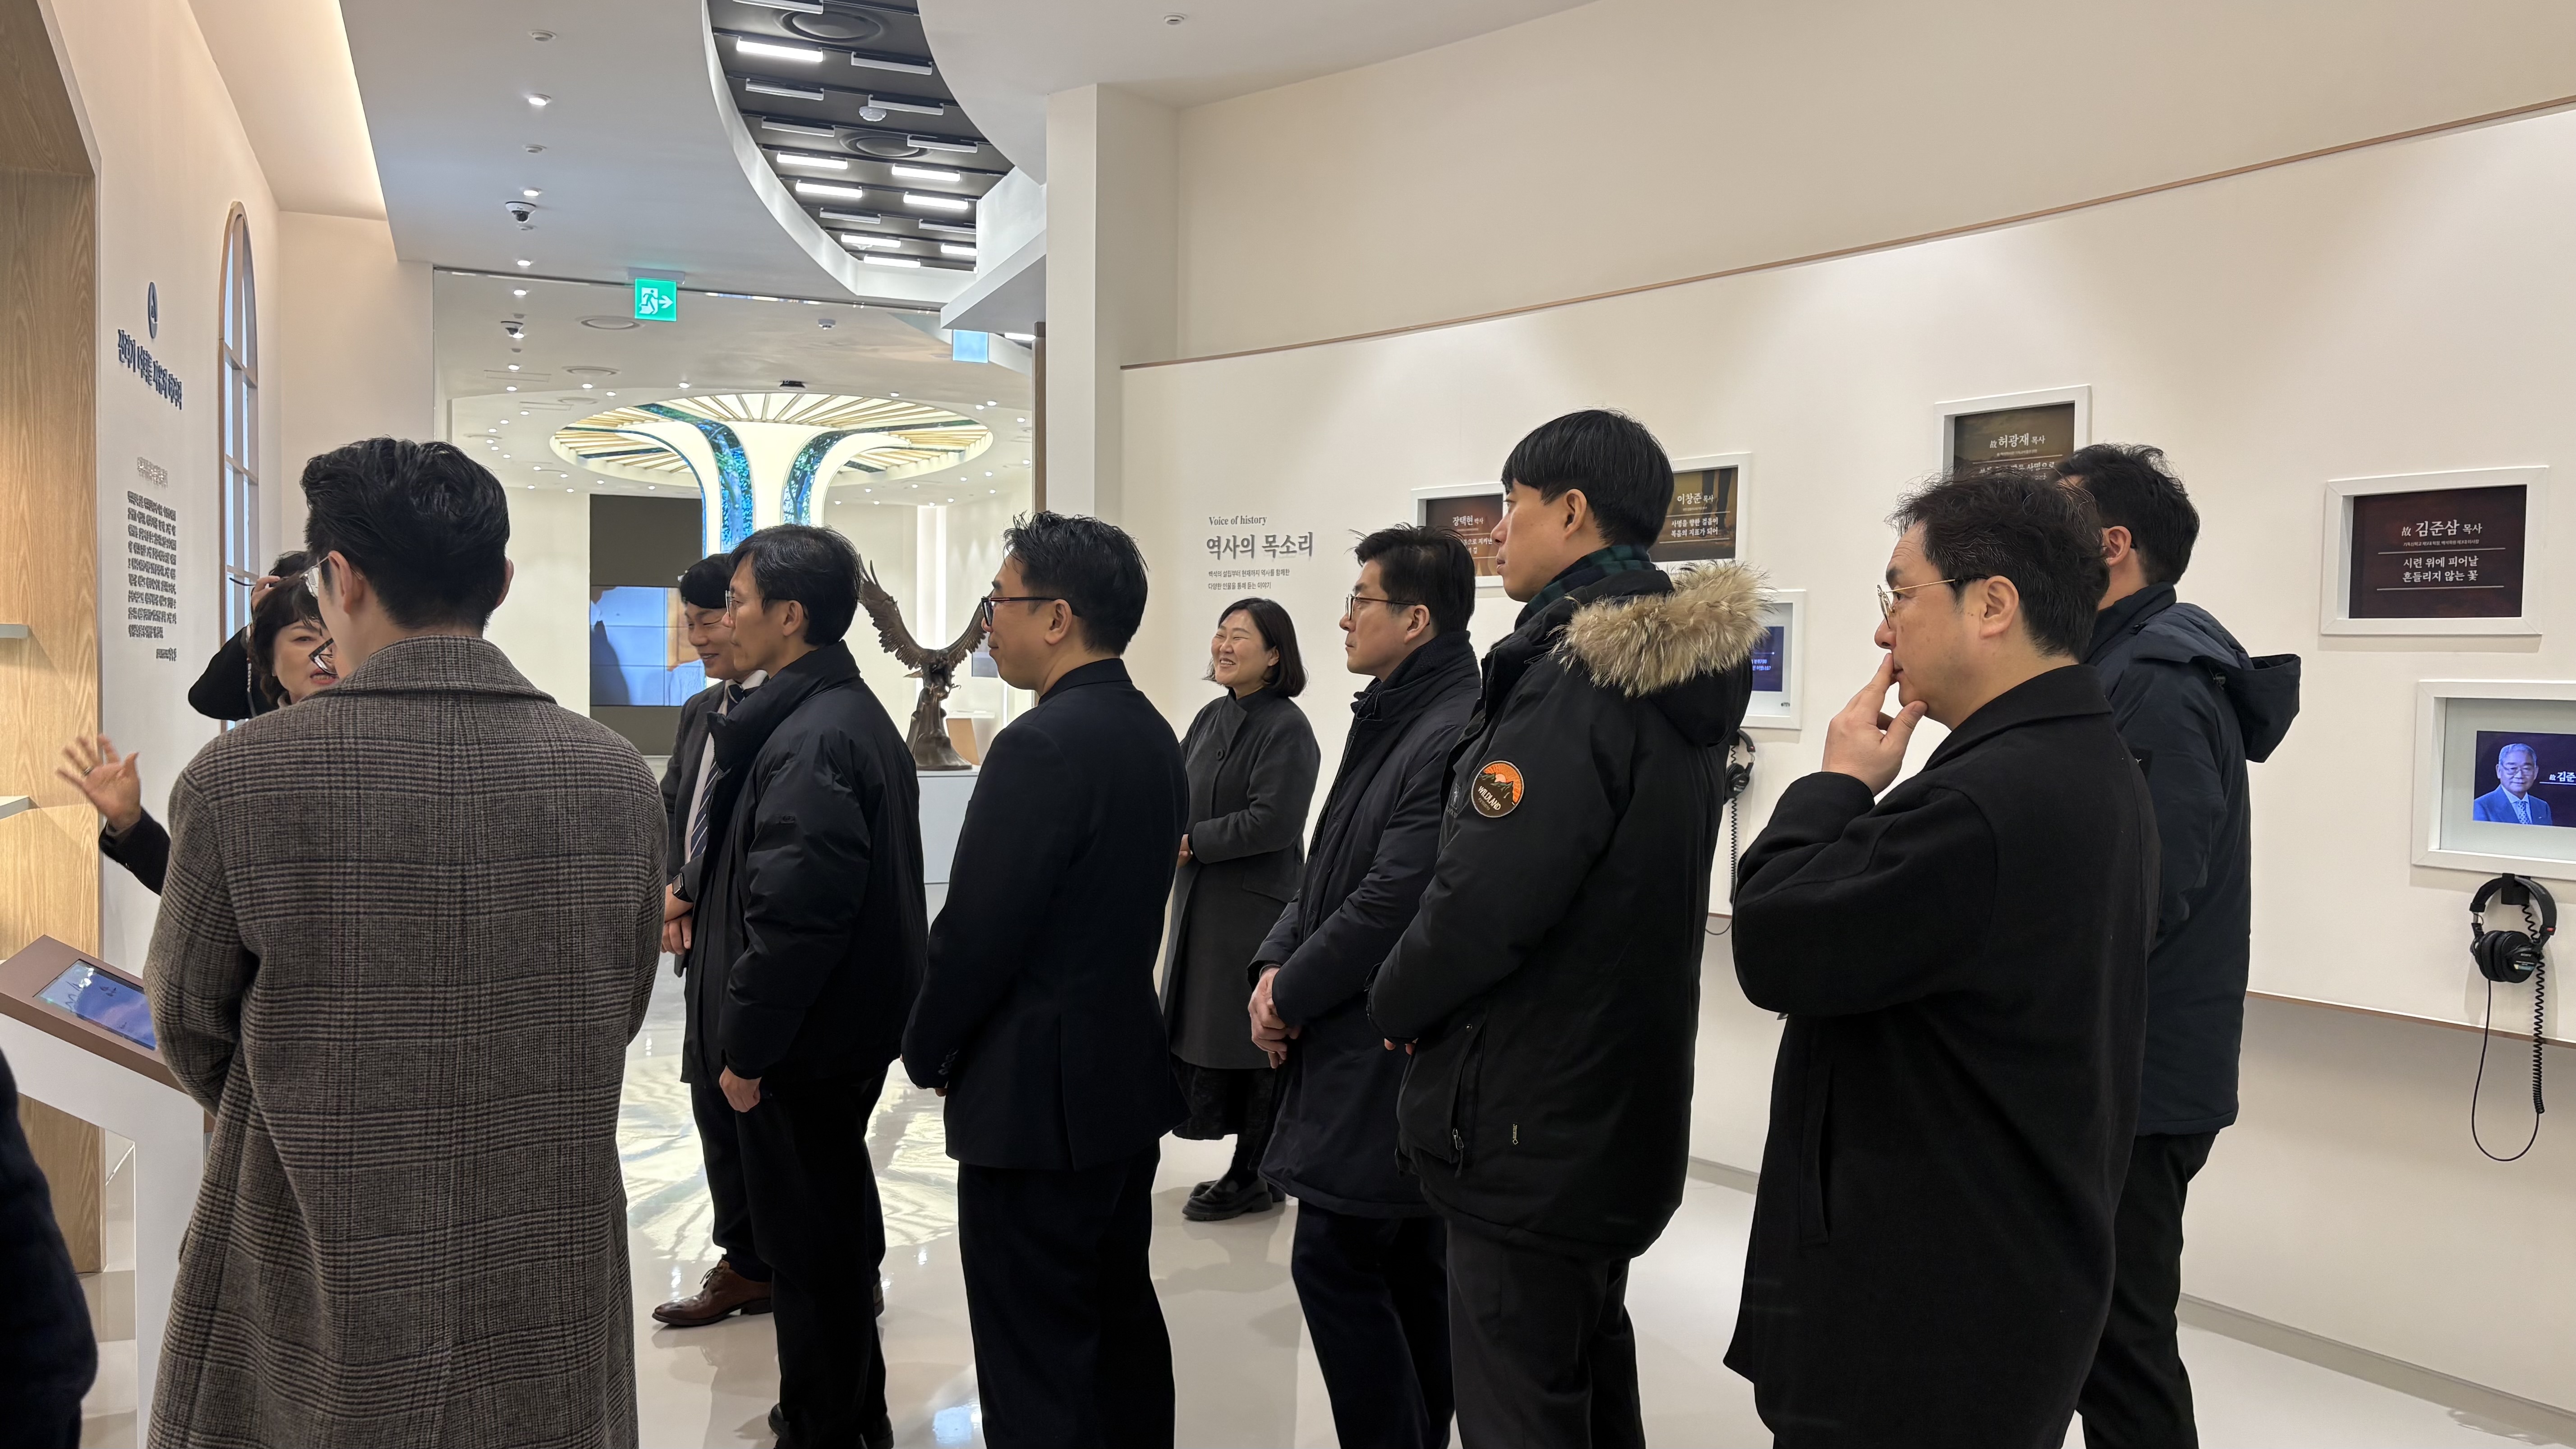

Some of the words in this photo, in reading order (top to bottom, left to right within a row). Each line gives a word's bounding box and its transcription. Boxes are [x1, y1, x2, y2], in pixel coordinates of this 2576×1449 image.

[1998, 433, 2029, 448] 허광재
[2031, 435, 2046, 444] 목사
[1677, 493, 1702, 505] 이창준
[1703, 495, 1713, 503] 목사
[1209, 516, 1229, 525] Voice
[1231, 516, 1239, 524] of
[1240, 515, 1267, 525] history
[1453, 515, 1473, 526] 장택현
[1702, 517, 1718, 525] 걸음이
[1671, 529, 1687, 538] 복음의
[1689, 528, 1705, 536] 지표가
[1707, 527, 1718, 535] 되어
[2401, 526, 2411, 536] 故
[2415, 520, 2460, 537] 김준삼
[2462, 523, 2482, 534] 목사
[1207, 534, 1255, 560] 역사의
[1262, 532, 1313, 558] 목소리
[2403, 557, 2422, 569] 시련
[2425, 557, 2445, 568] 위에
[2402, 570, 2441, 582] 흔들리지
[2445, 570, 2465, 581] 않는
[2467, 570, 2479, 581] 꽃
[1478, 786, 1501, 810] WILDLAND
